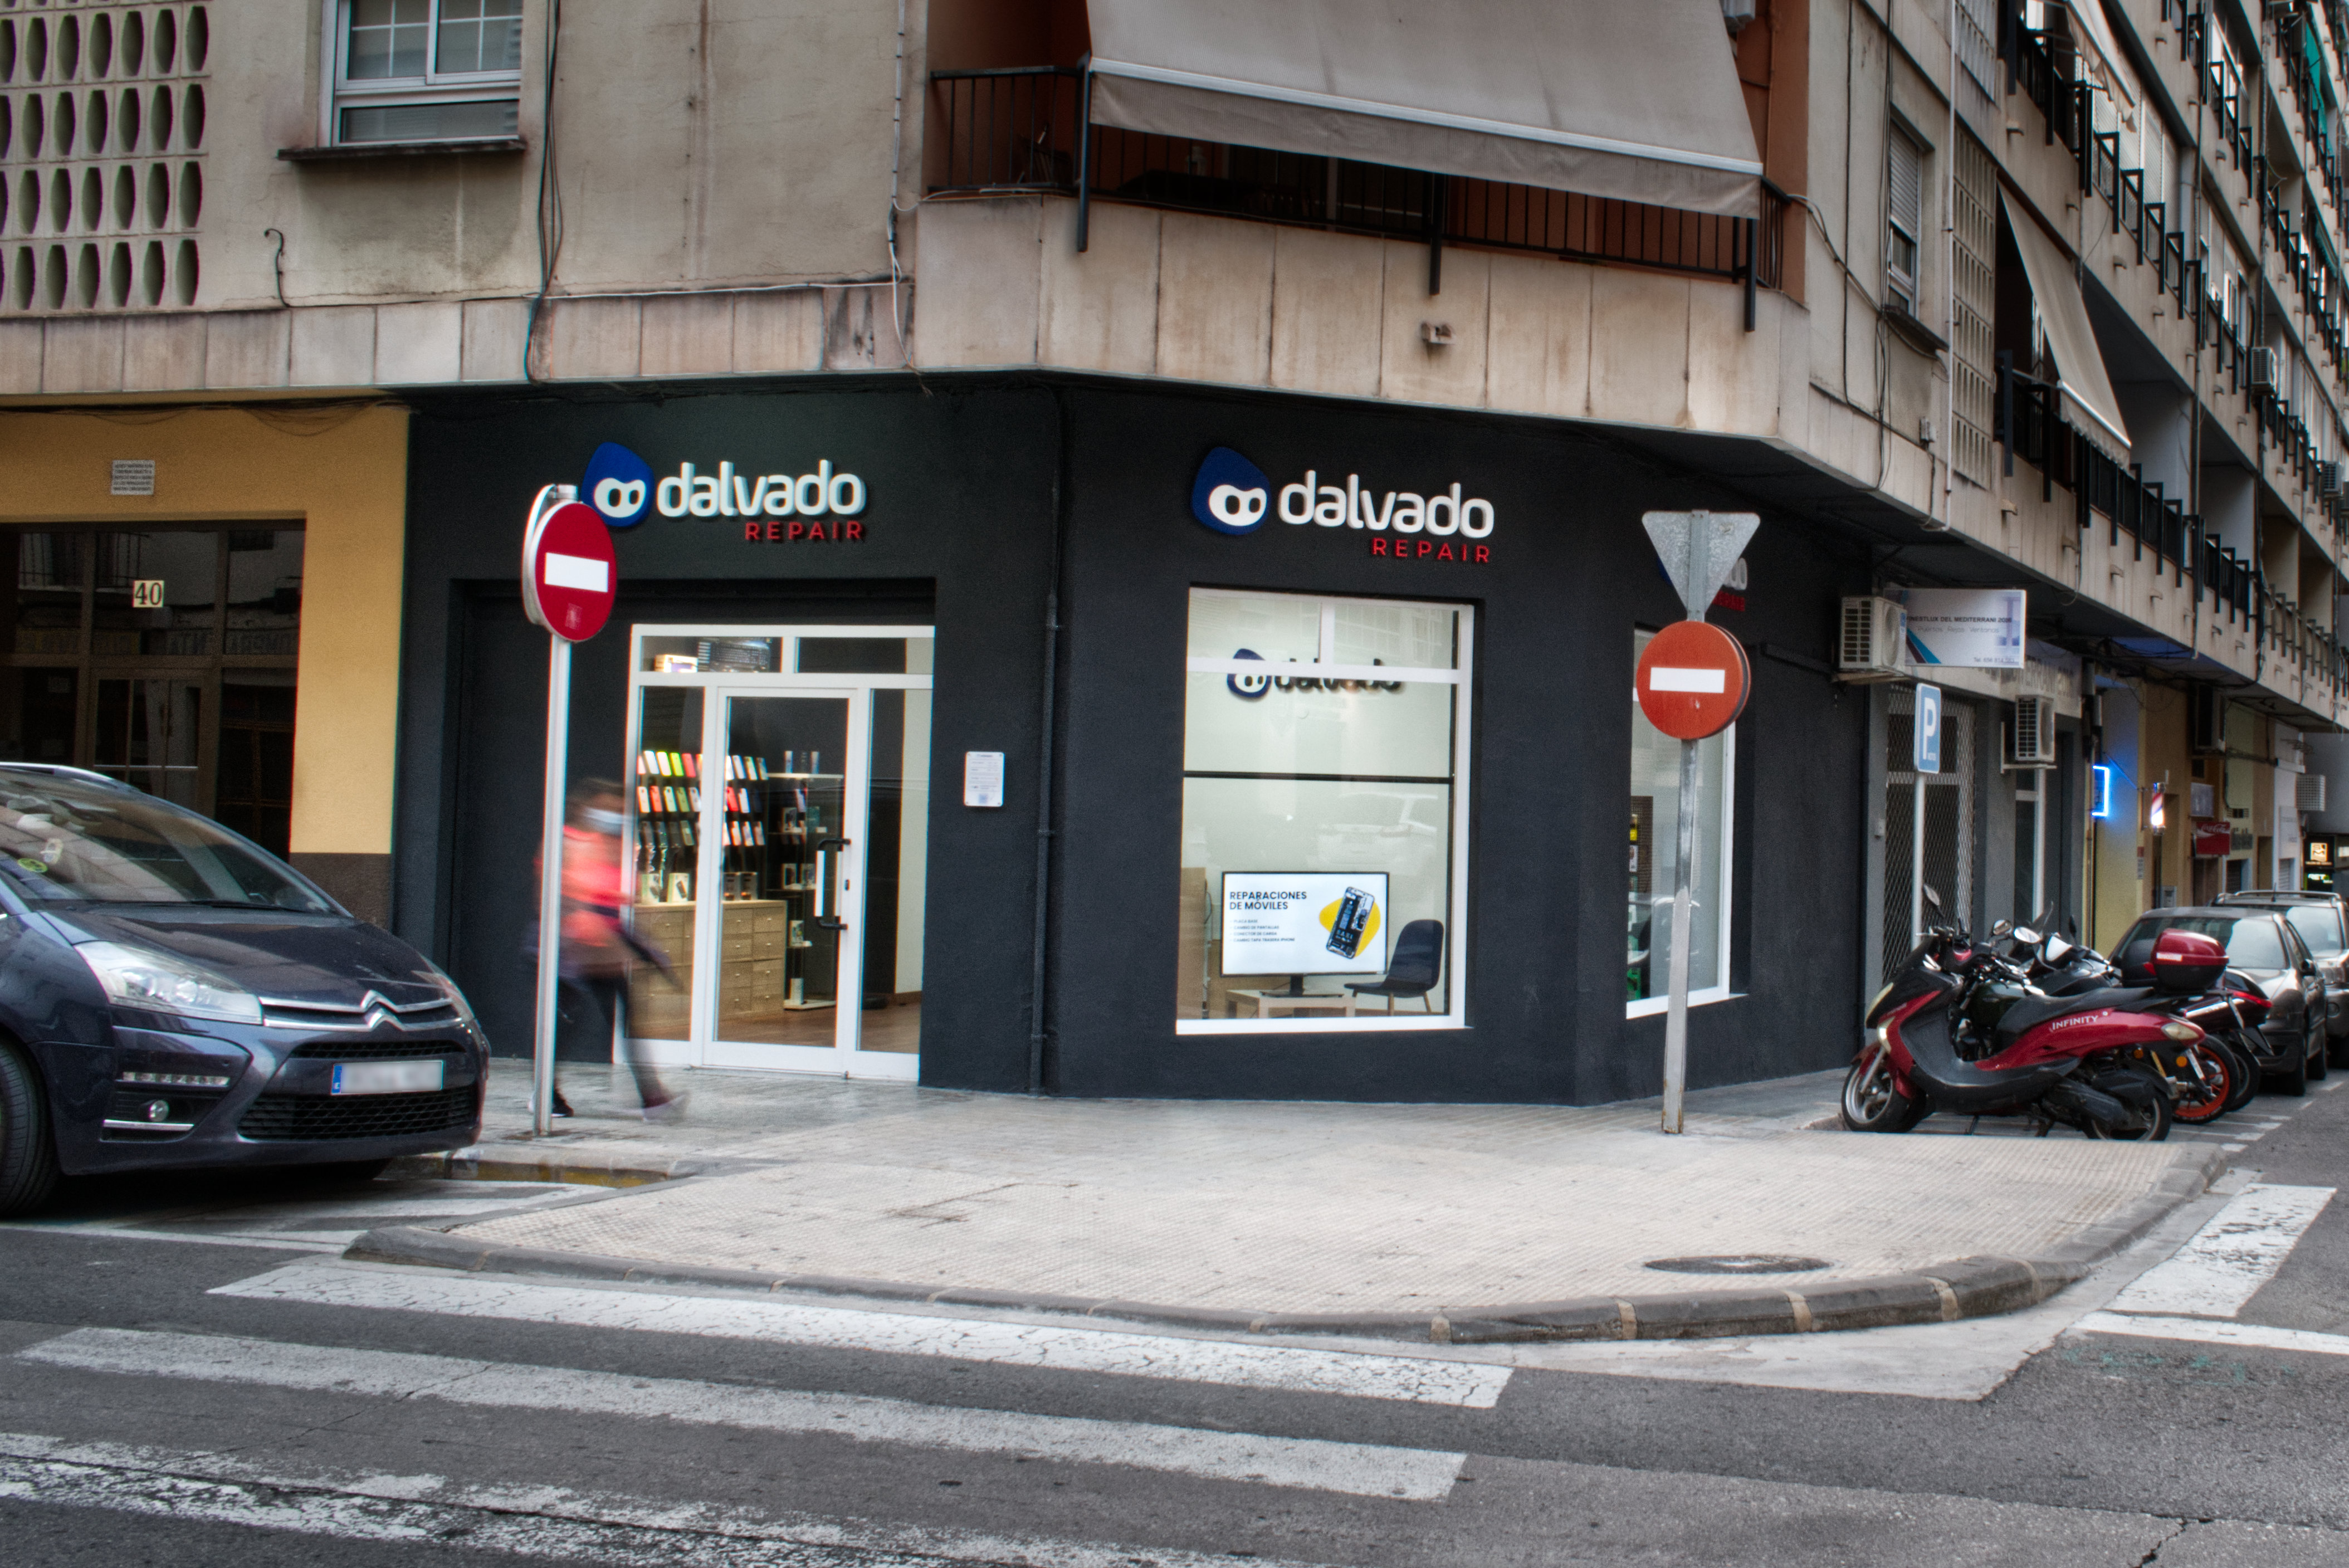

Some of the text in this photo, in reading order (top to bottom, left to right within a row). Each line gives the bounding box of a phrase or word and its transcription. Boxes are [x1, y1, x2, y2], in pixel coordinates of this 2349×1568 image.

[657, 459, 866, 517] dalvado
[1278, 470, 1494, 538] dalvado
[745, 520, 862, 541] REPAIR
[1371, 538, 1490, 563] REPAIR
[135, 583, 162, 605] 40
[1923, 697, 1936, 760] P
[1230, 891, 1307, 900] REPARACIONES
[1245, 899, 1288, 910] MÓVILES
[2052, 1015, 2098, 1030] INFINITY
